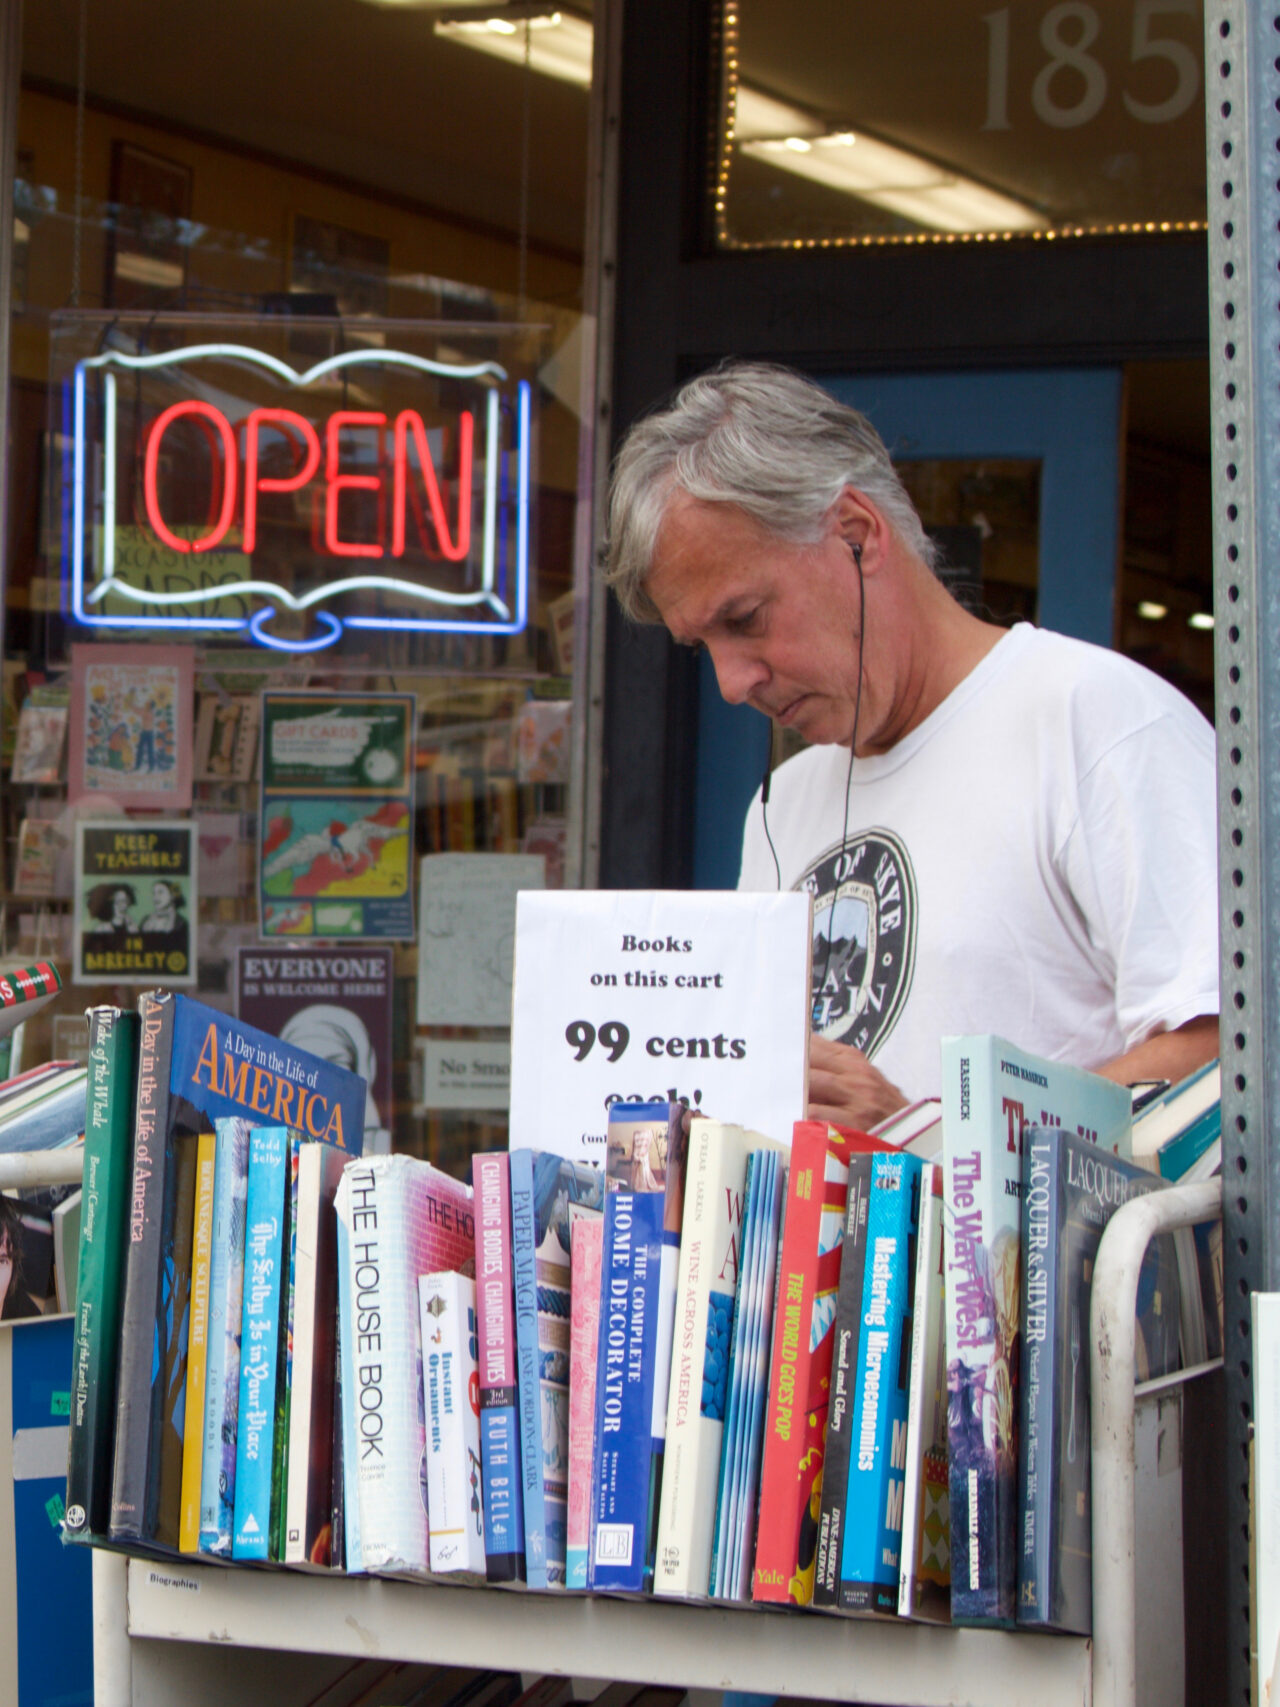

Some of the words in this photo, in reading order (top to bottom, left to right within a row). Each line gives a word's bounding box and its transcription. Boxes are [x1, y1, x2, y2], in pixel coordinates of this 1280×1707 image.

[144, 399, 474, 560] OPEN
[101, 570, 249, 634] CARDS
[274, 725, 306, 739] GIFT
[310, 725, 358, 739] CARDS
[96, 853, 181, 868] TEACHERS
[115, 834, 157, 850] KEEP
[86, 951, 165, 970] BERKELEY
[126, 937, 142, 950] IN
[621, 935, 693, 952] Books
[244, 958, 385, 979] EVERYONE
[244, 983, 258, 996] IS
[263, 983, 339, 996] WELCOME
[344, 983, 386, 996] HERE
[590, 973, 618, 987] on
[625, 970, 668, 988] this
[675, 973, 724, 988] cart
[96, 1011, 113, 1045] Wake
[146, 1000, 163, 1015] A
[141, 1018, 163, 1052] Day
[565, 1020, 630, 1063] 99
[646, 1034, 747, 1059] cents
[142, 1055, 160, 1073] in
[224, 1030, 233, 1051] A
[235, 1035, 256, 1064] Day
[256, 1044, 267, 1066] in
[269, 1051, 284, 1074] the
[286, 1058, 305, 1085] Life
[307, 1070, 319, 1089] of
[440, 1059, 467, 1075] No
[1001, 1060, 1020, 1076] PETER
[1021, 1067, 1048, 1089] HASSRICK
[140, 1078, 157, 1105] the
[192, 1023, 347, 1148] AMERICA
[960, 1058, 970, 1121] HASSRICK
[92, 1086, 109, 1128] Whale
[137, 1109, 156, 1142] Life
[136, 1146, 153, 1165] of
[252, 1151, 282, 1167] Selby
[253, 1139, 281, 1150] Todd
[481, 1161, 502, 1227] CHANGING
[953, 1150, 982, 1209] The
[1026, 1144, 1051, 1251] LACQUER
[1068, 1148, 1129, 1207] LACQUER
[131, 1166, 152, 1243] America
[196, 1160, 212, 1257] ROMANESQUE
[352, 1168, 377, 1232] THE
[426, 1195, 452, 1231] THE
[695, 1181, 705, 1222] LARKIN
[249, 1217, 277, 1256] The
[513, 1190, 532, 1254] PAPER
[612, 1195, 634, 1268] HOME
[482, 1229, 503, 1278] BODIES,
[633, 1245, 649, 1280] THE
[688, 1241, 701, 1283] WINE
[949, 1210, 983, 1281] Way
[1028, 1253, 1045, 1267] &
[247, 1259, 274, 1315] Selby
[354, 1242, 382, 1354] HOUSE
[516, 1259, 535, 1327] MAGIC
[786, 1272, 804, 1304] THE
[864, 1237, 897, 1326] Mastering
[80, 1301, 92, 1336] Friends
[193, 1262, 209, 1346] SCULPTURE
[485, 1280, 505, 1347] CHANGING
[683, 1288, 697, 1350] ACROSS
[956, 1276, 984, 1350] West
[1027, 1268, 1048, 1344] SILVER
[628, 1286, 646, 1383] COMPLETE
[781, 1305, 803, 1360] WORLD
[836, 1329, 851, 1368] Sound
[486, 1349, 506, 1382] LIVES
[520, 1345, 533, 1379] JANE
[603, 1279, 629, 1433] DECORATOR
[243, 1363, 270, 1410] Your
[428, 1353, 442, 1453] Ornaments
[442, 1351, 453, 1416] Instant
[489, 1389, 504, 1399] 3rd
[676, 1352, 694, 1428] AMERICA
[777, 1363, 797, 1404] GOES
[836, 1371, 848, 1395] and
[858, 1331, 889, 1472] Microeconomics
[359, 1364, 384, 1461] BOOK
[775, 1406, 794, 1441] POP
[831, 1397, 846, 1432] Glory
[245, 1409, 267, 1461] Place
[488, 1415, 508, 1465] RUTH
[522, 1380, 539, 1492] GORDON-CLARK
[490, 1477, 510, 1523] BELL
[235, 1533, 264, 1545] Abrams
[1023, 1510, 1036, 1556] KIMURA
[150, 1573, 198, 1591] Biographies
[757, 1568, 784, 1586] Yale
